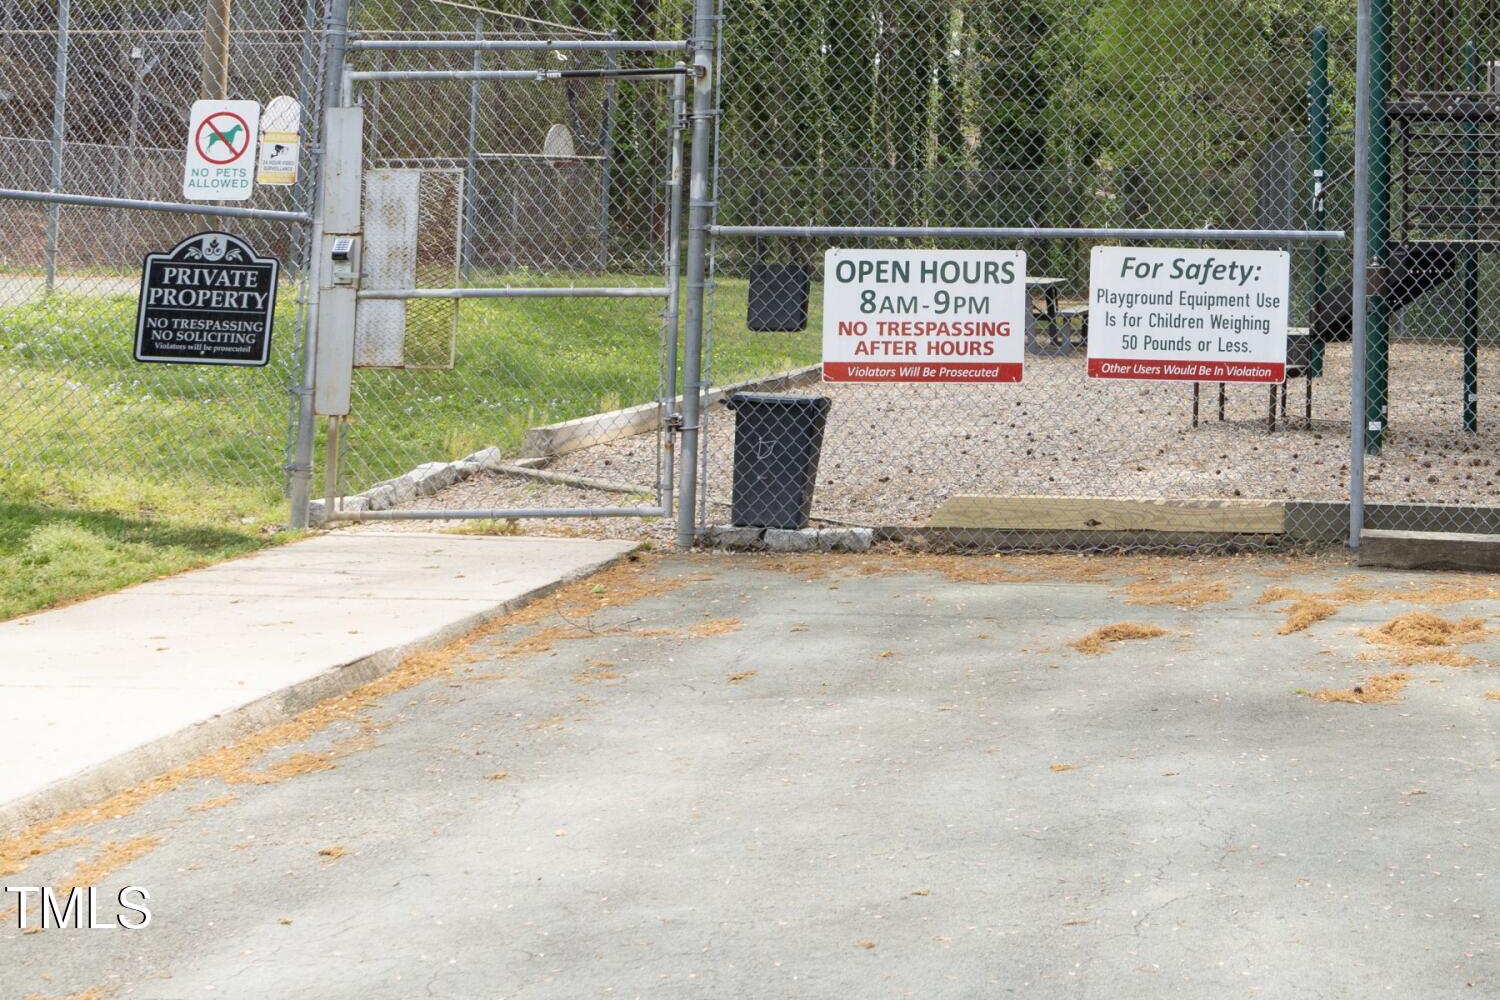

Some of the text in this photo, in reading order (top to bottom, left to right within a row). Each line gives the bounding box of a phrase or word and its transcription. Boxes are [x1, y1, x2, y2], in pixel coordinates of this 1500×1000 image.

[191, 168, 247, 178] NO PETS
[188, 179, 249, 188] ALLOWED
[162, 267, 259, 288] PRIVATE
[835, 260, 1015, 284] OPEN HOURS
[1120, 256, 1262, 286] For Safety:
[147, 288, 268, 309] PROPERTY
[1097, 289, 1280, 310] Playground Equipment Use
[147, 317, 263, 332] NO TRESPASSING
[838, 321, 1011, 337] NO TRESPASSING
[1105, 312, 1270, 334] Is for Children Weighing
[151, 330, 256, 344] NO SOLICITING
[1122, 334, 1252, 353] 50 Pounds or Less.
[155, 342, 186, 350] Violators
[188, 343, 202, 351] will
[213, 345, 251, 353] prosecuted
[854, 341, 995, 356] AFTER HOURS
[847, 366, 999, 377] Violators Will Be Prosecuted
[1101, 363, 1272, 377] Other Users Would Be In Violation
